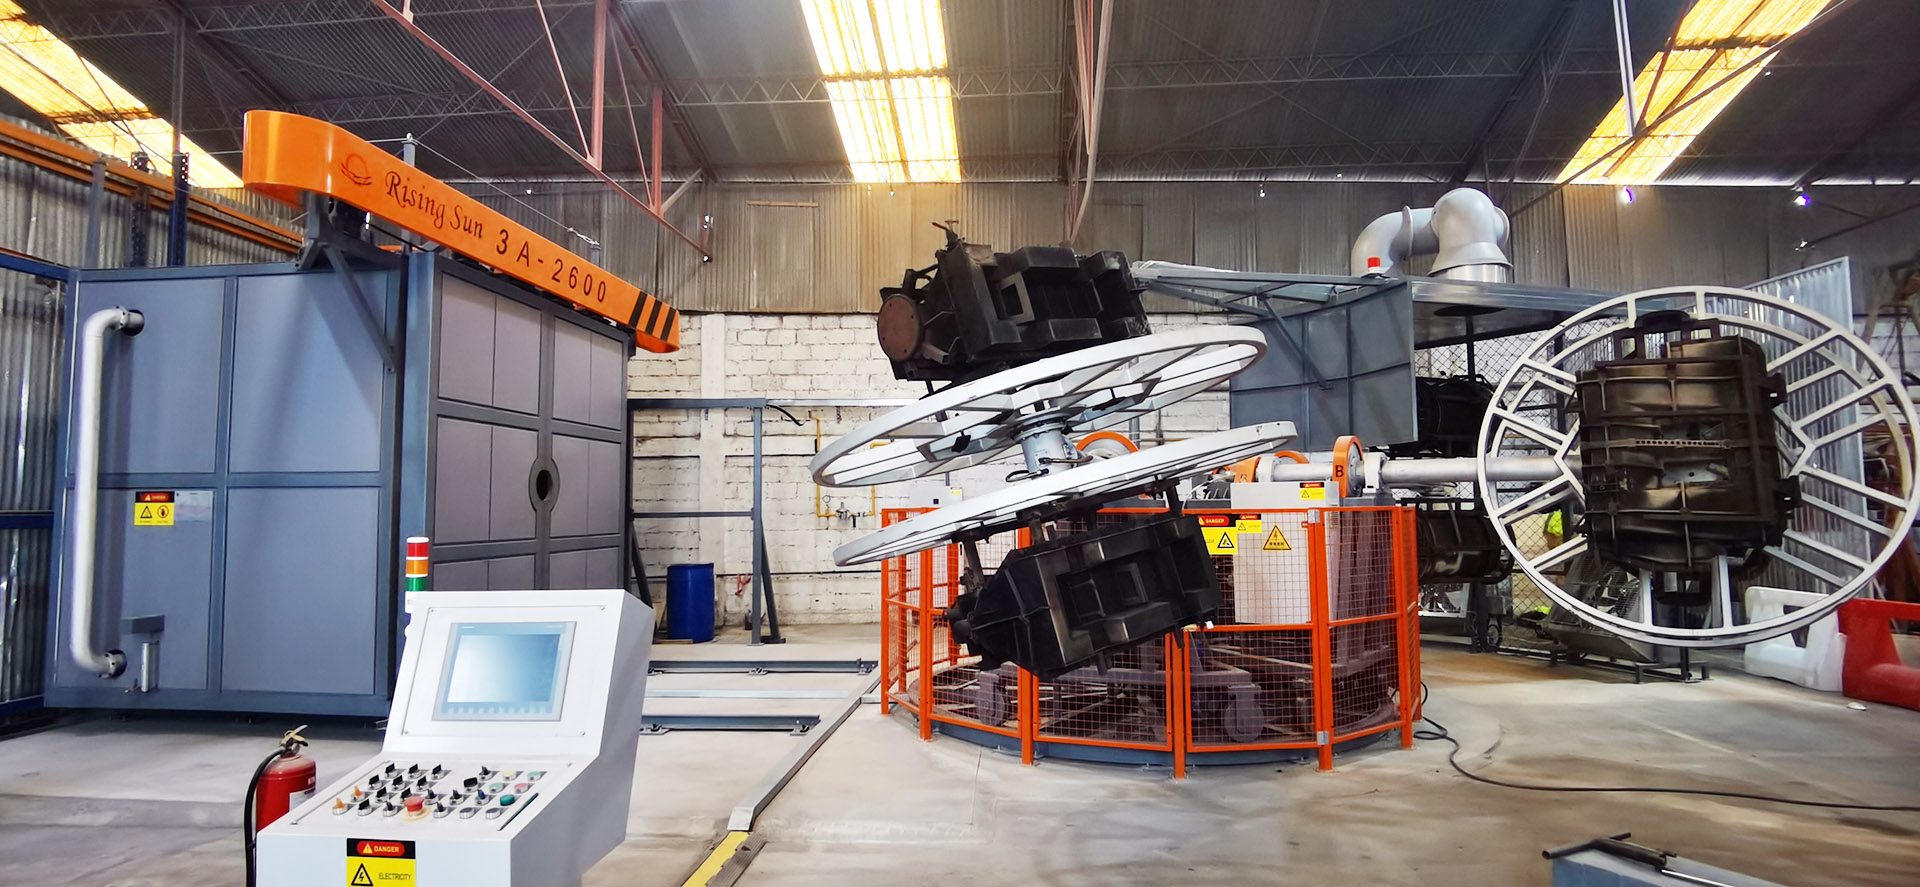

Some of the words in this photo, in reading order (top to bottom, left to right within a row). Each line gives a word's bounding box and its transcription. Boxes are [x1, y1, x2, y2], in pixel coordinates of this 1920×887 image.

[385, 171, 446, 230] Rising
[450, 205, 483, 239] Sun
[1335, 465, 1344, 478] B
[378, 872, 411, 880] ELECTRICITY
